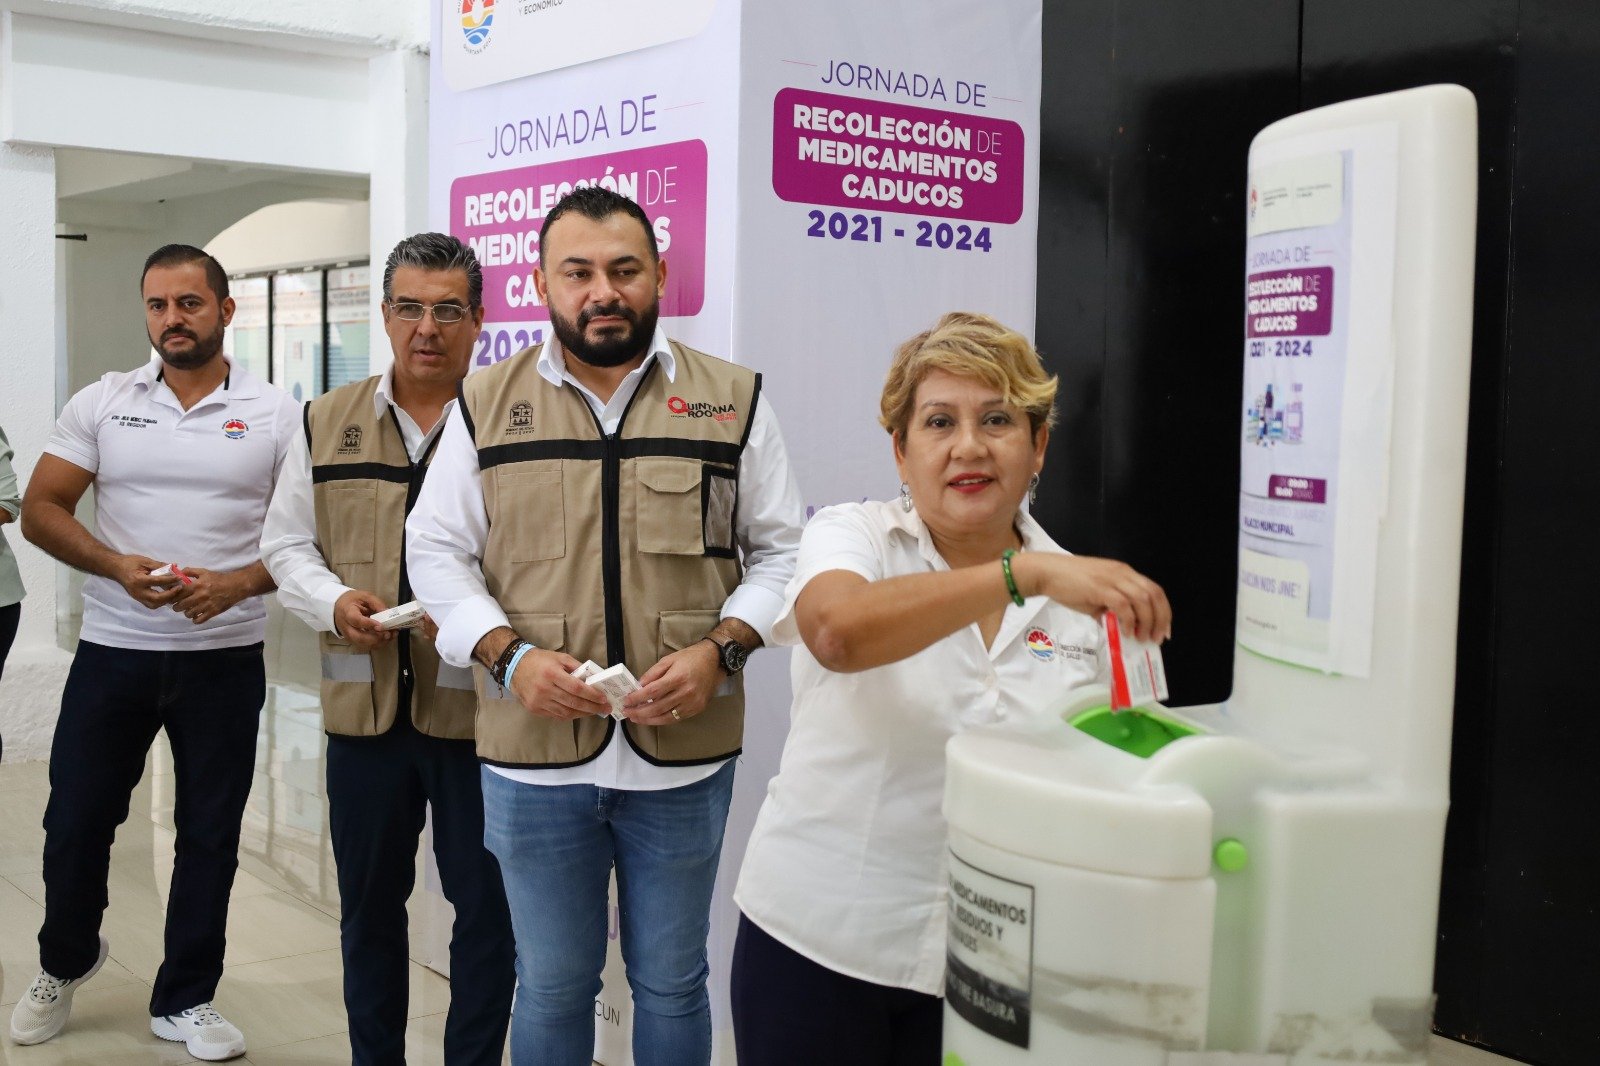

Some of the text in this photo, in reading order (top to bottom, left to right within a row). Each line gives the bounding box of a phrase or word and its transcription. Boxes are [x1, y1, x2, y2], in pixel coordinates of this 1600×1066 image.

[821, 60, 987, 107] JORNADA DE
[487, 94, 657, 159] JORNADA DE
[793, 104, 1002, 155] RECOLECCIÓN DE
[798, 137, 998, 184] MEDICAMENTOS
[646, 166, 677, 205] DE
[842, 174, 964, 209] CADUCOS
[807, 210, 882, 243] 2021
[915, 220, 992, 252] 2024
[1294, 246, 1311, 262] DE
[1304, 275, 1321, 292] DE
[1275, 340, 1312, 356] 2024
[667, 396, 736, 414] QUINTANA
[997, 926, 1003, 941] Y
